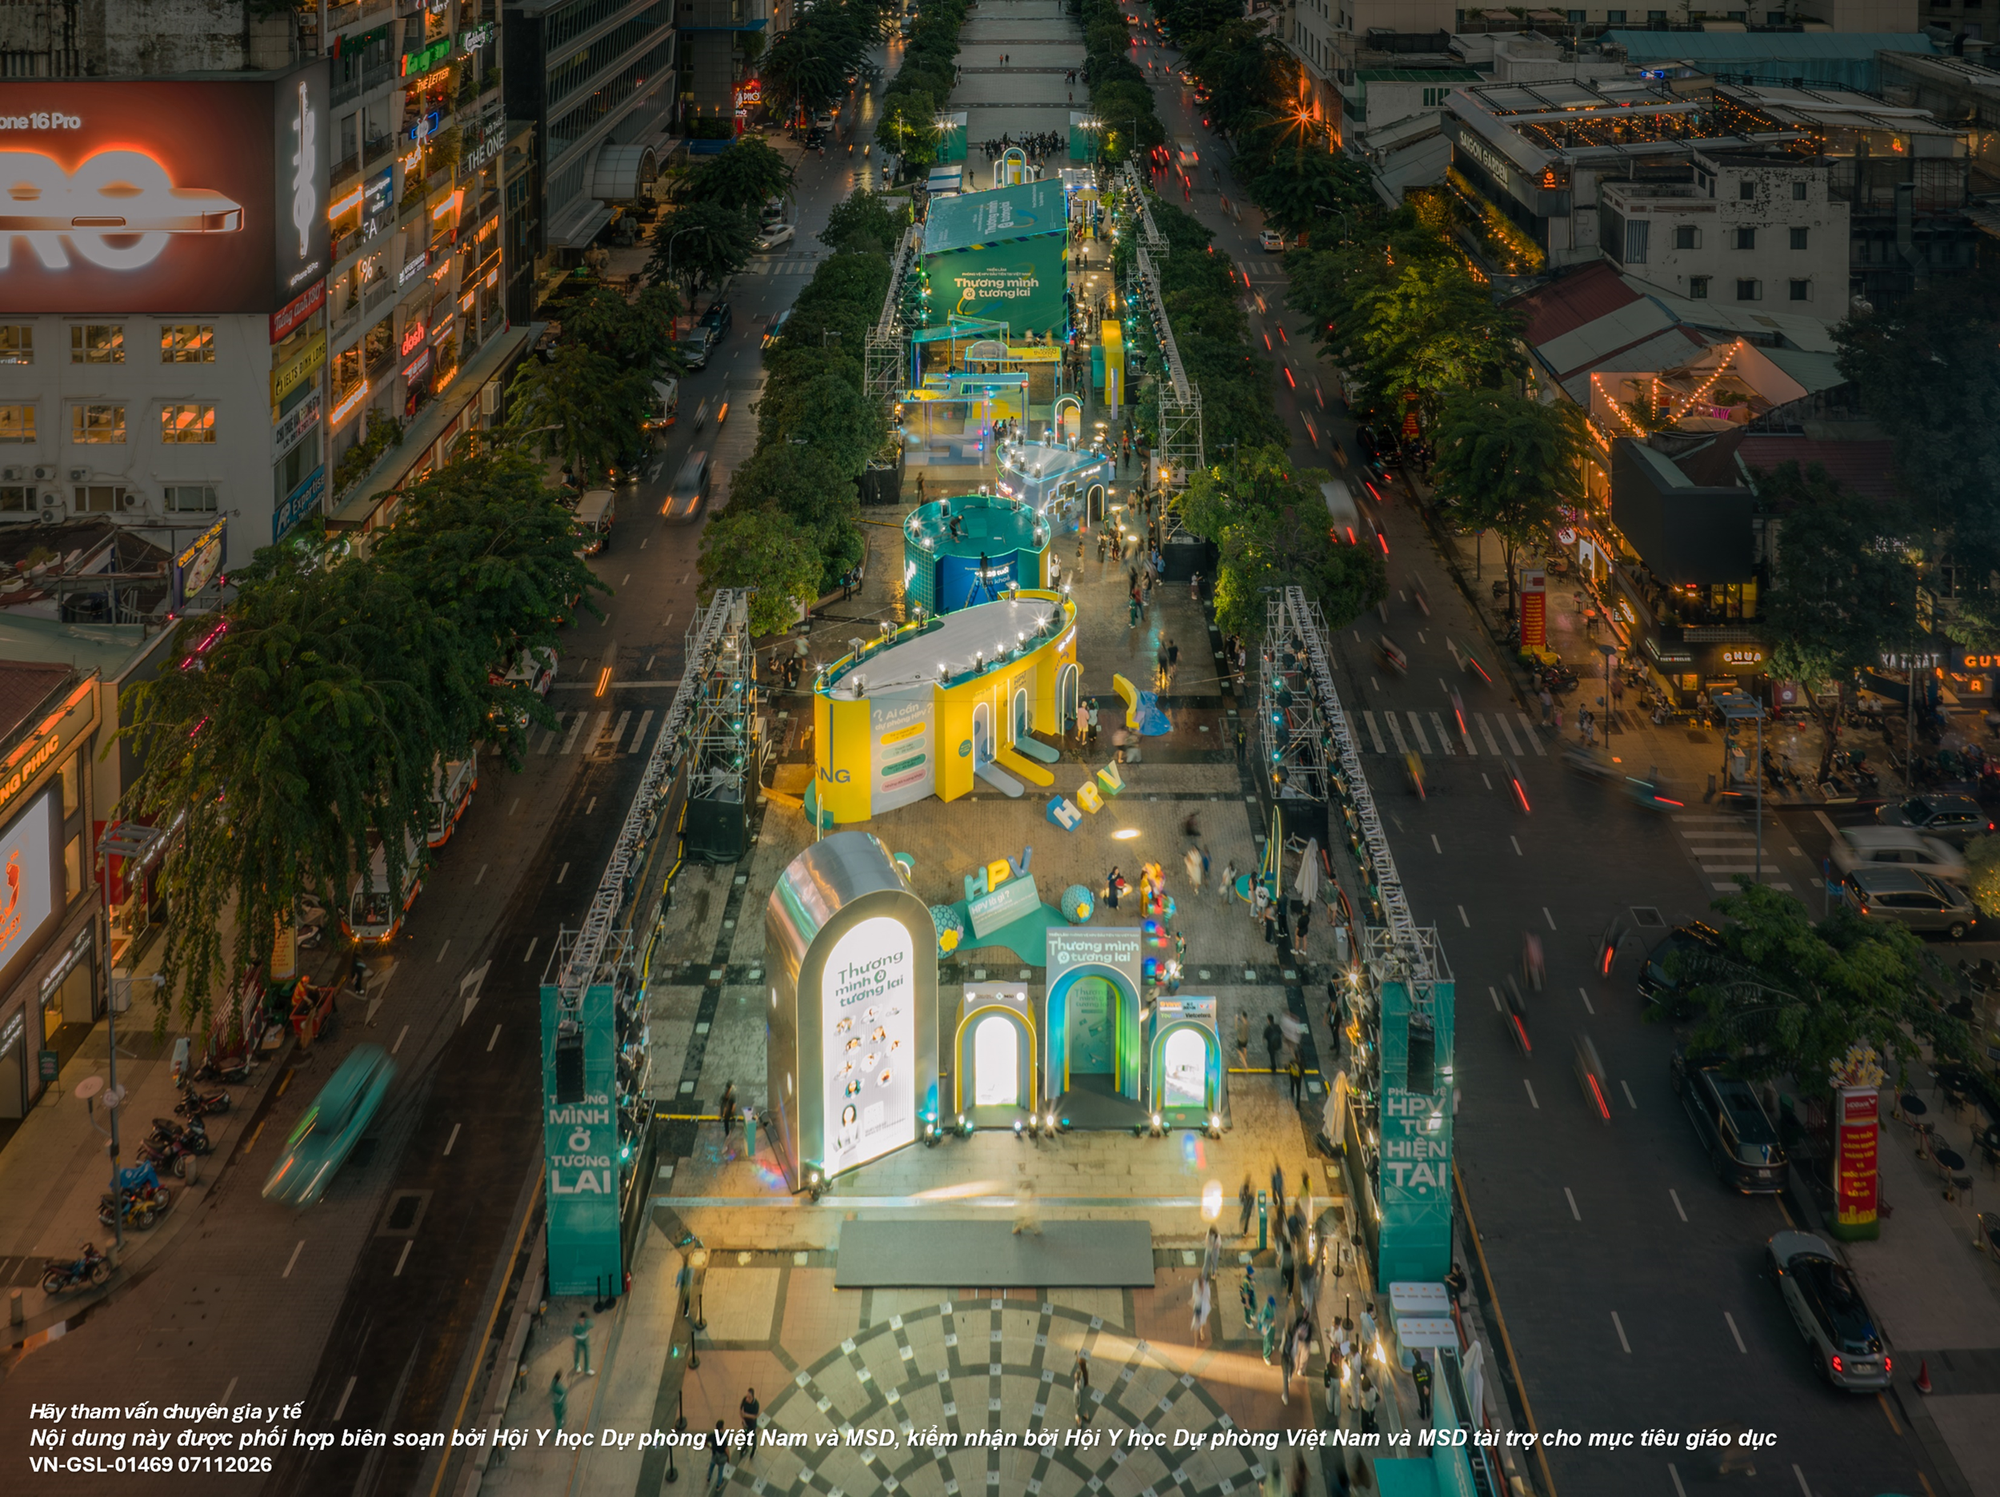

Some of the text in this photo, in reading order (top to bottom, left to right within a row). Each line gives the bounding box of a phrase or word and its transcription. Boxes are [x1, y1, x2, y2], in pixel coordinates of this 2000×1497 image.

[30, 113, 50, 130] 16
[51, 113, 81, 130] Pro
[468, 131, 504, 172] THE ONE
[1460, 131, 1483, 162] SAIGON
[1482, 150, 1508, 183] GARDEN
[953, 277, 1039, 289] Thương mình
[978, 289, 1015, 299] tương
[1016, 287, 1031, 297] lai
[274, 306, 293, 332] Tiếng
[283, 366, 298, 389] IELTS
[293, 473, 325, 516] Expertise
[886, 709, 897, 720] Ai
[899, 702, 919, 716] cần
[875, 722, 887, 731] dự
[887, 716, 911, 728] phòng
[1053, 760, 1121, 829] HPV
[964, 845, 1033, 903] HPV
[971, 900, 988, 915] HPV
[989, 896, 998, 907] là
[997, 892, 1005, 904] gì
[1048, 936, 1139, 956] Thương mình
[1071, 952, 1112, 963] tương
[1114, 952, 1131, 962] lai
[838, 951, 904, 985] Thương
[835, 976, 871, 997] mình
[840, 974, 904, 1007] tương lai
[549, 1105, 609, 1125] MÌNH
[1387, 1098, 1446, 1117] HPV
[568, 1126, 591, 1152] Ở
[1387, 1136, 1447, 1162] HIỆN
[551, 1154, 611, 1168] TƯƠNG
[552, 1169, 611, 1194] LAI
[1387, 1162, 1447, 1195] TẠI
